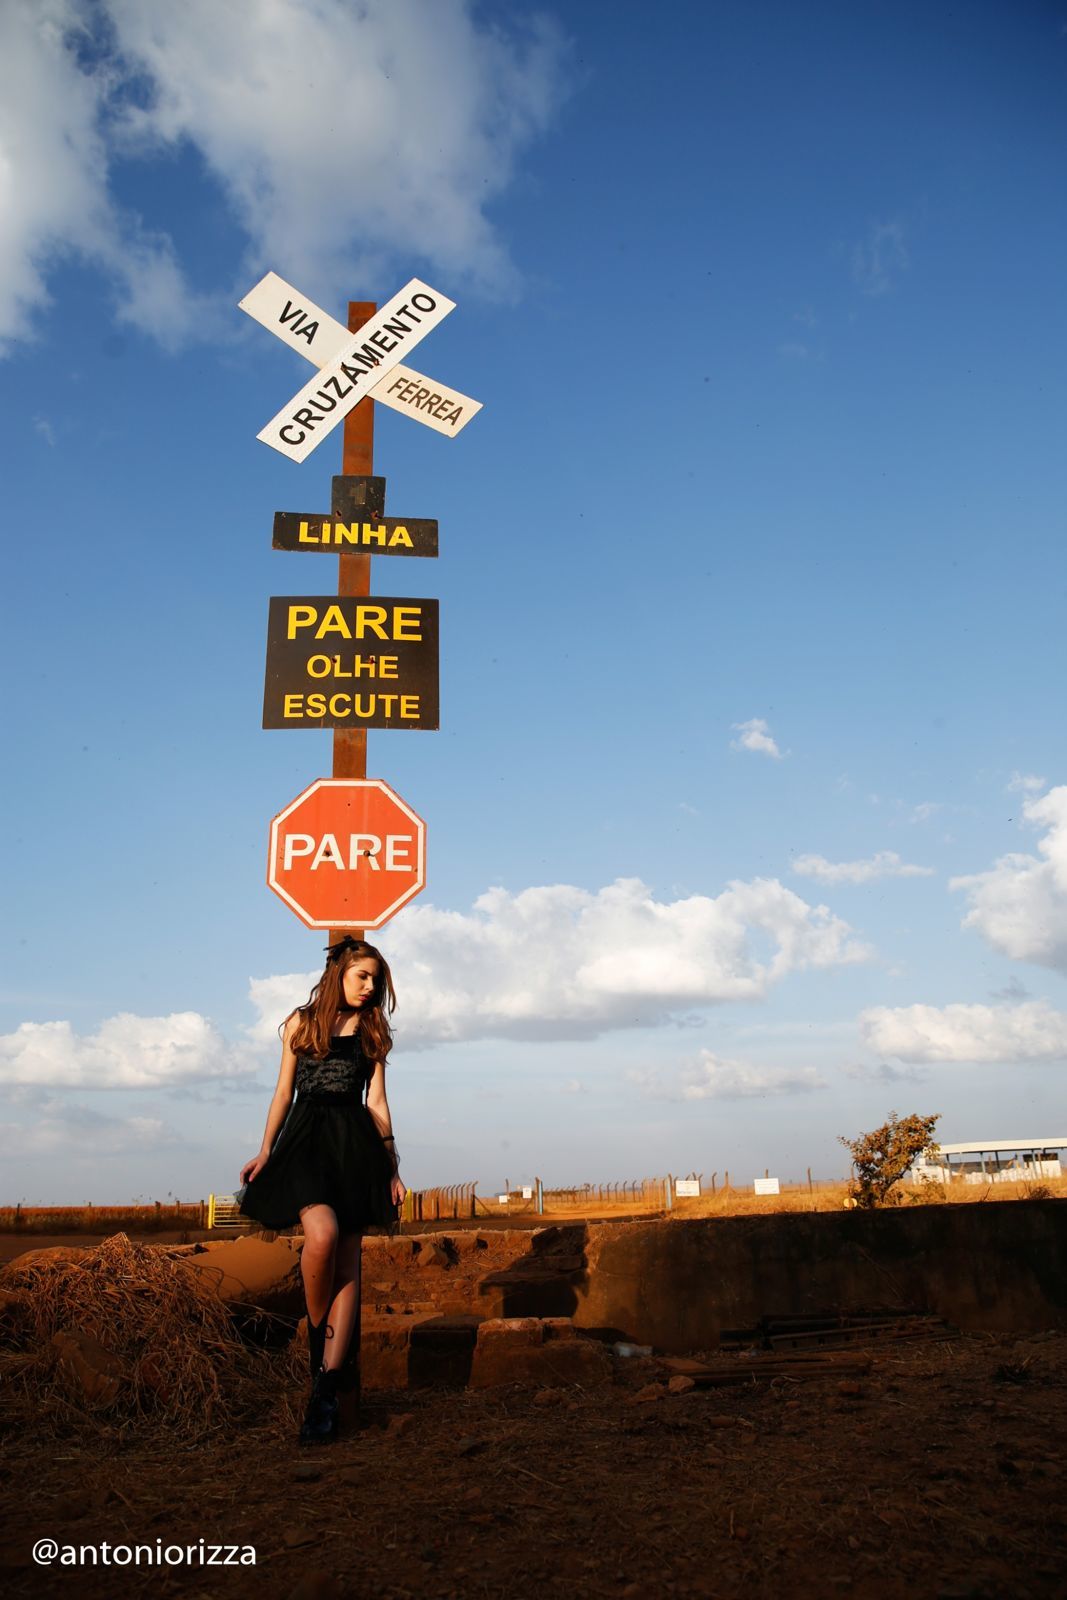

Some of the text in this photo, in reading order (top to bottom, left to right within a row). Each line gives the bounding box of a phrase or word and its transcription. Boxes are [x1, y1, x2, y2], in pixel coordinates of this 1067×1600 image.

[278, 300, 320, 345] VIA
[279, 293, 437, 446] CRUZAMENTO
[387, 379, 464, 426] FÉRREA
[298, 521, 414, 548] LINHA
[287, 605, 422, 641] PARE
[307, 655, 399, 679] OLHE
[283, 693, 421, 719] ESCUTE
[283, 833, 413, 872] PARE
